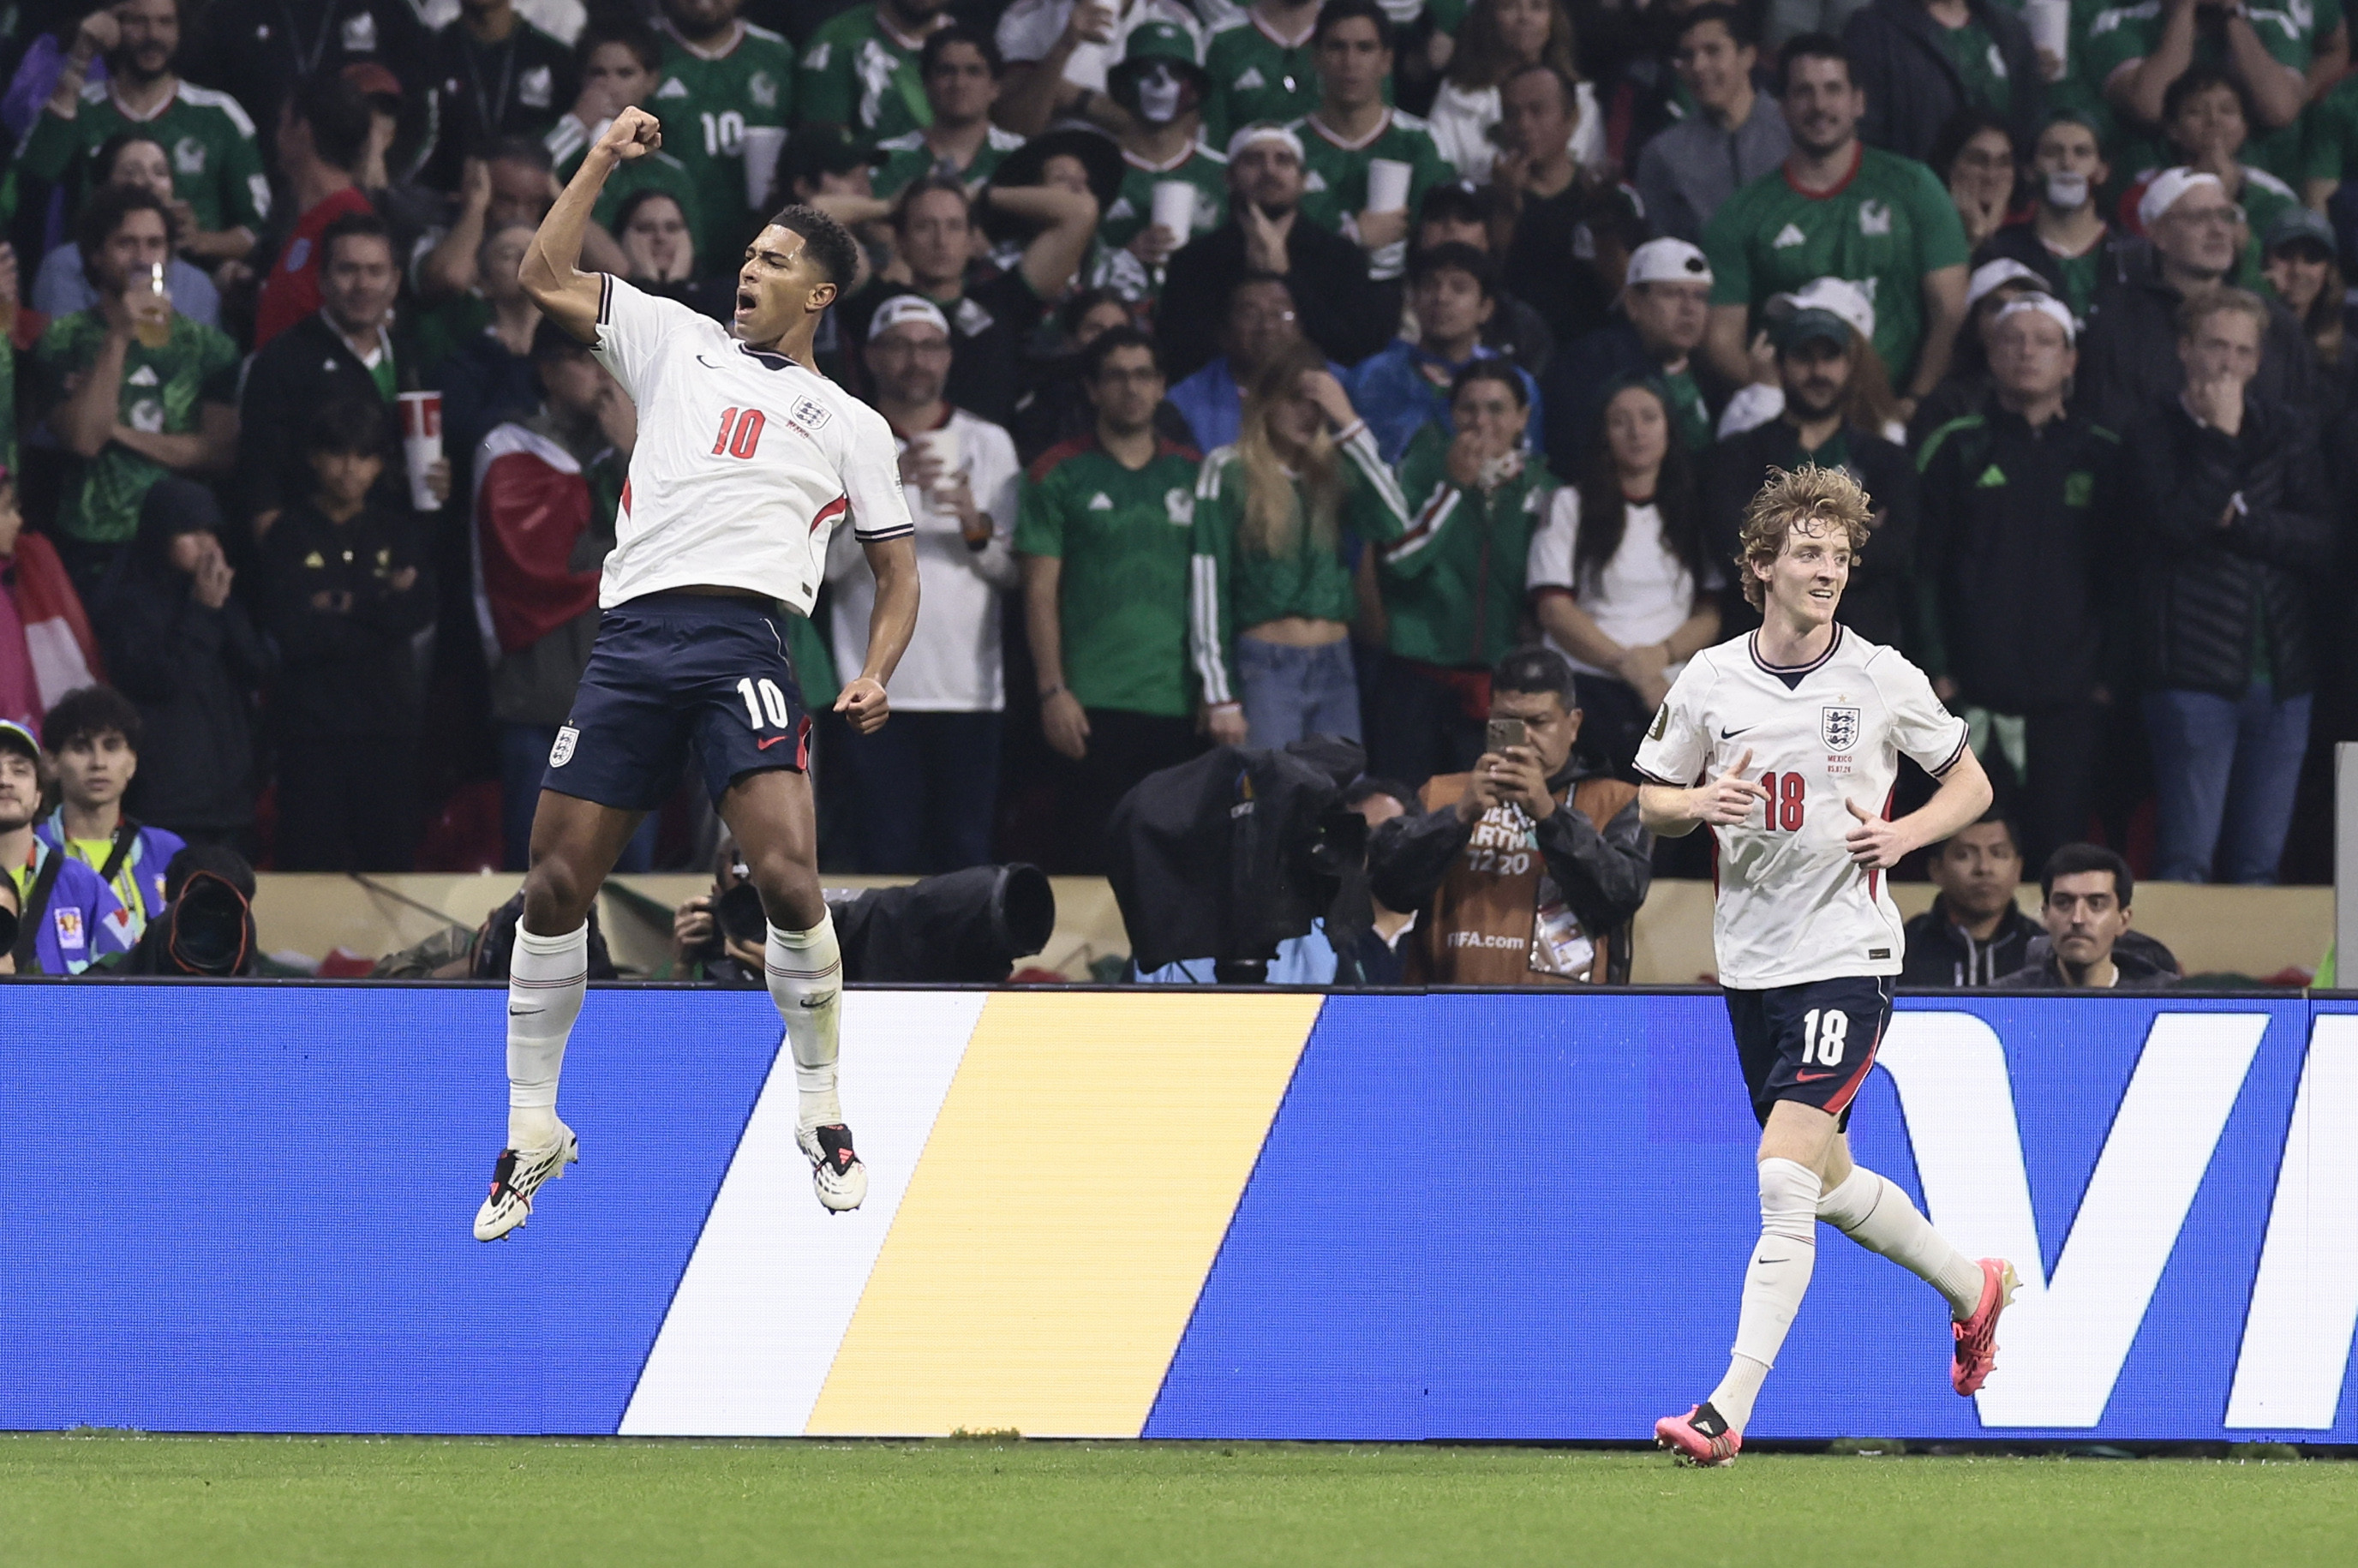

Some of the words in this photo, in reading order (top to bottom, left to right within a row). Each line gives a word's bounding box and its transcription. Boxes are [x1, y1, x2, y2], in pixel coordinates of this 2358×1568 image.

[701, 111, 744, 155] 10
[711, 407, 766, 459] 10
[737, 678, 788, 729] 10
[1761, 771, 1805, 831] 18
[1802, 1008, 1848, 1067] 18
